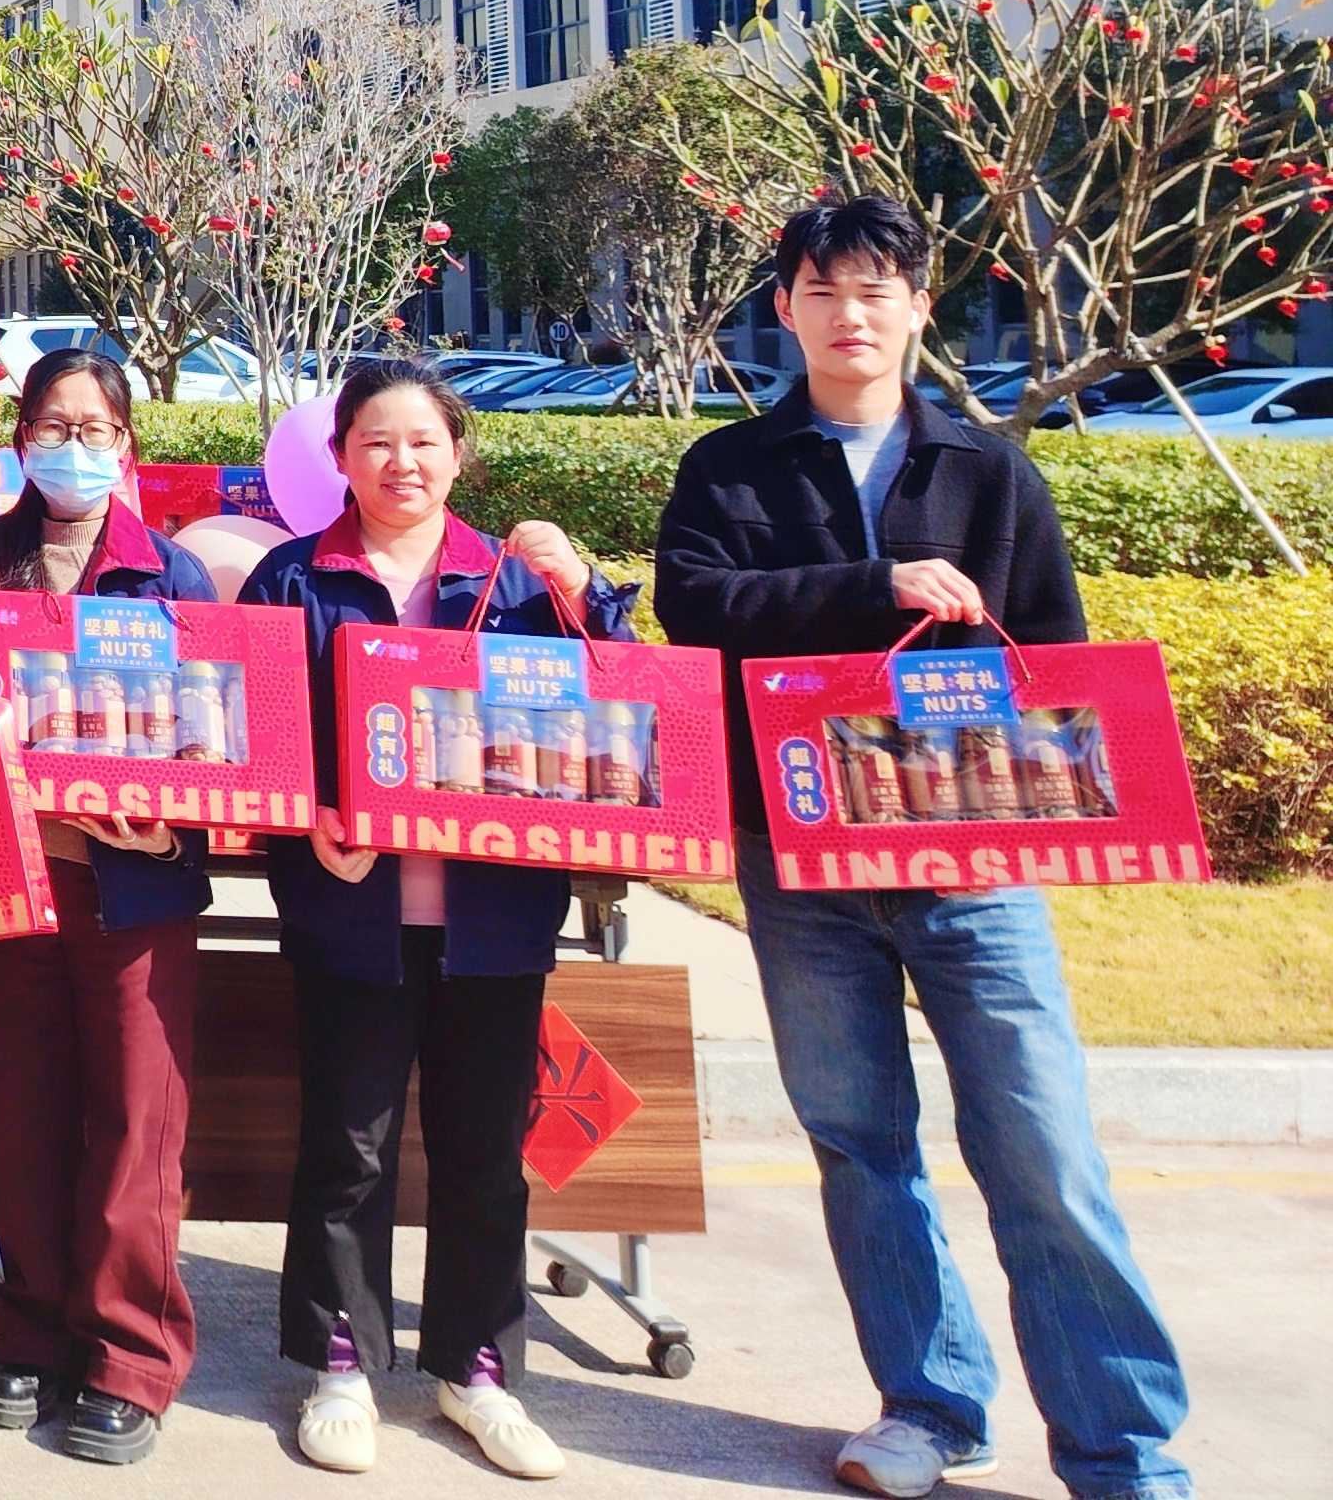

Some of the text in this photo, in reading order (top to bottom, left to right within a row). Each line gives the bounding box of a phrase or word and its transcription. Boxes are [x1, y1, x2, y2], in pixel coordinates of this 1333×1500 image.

[99, 641, 154, 658] NUTS
[505, 678, 563, 697] NUTS
[923, 694, 987, 713] NUTS
